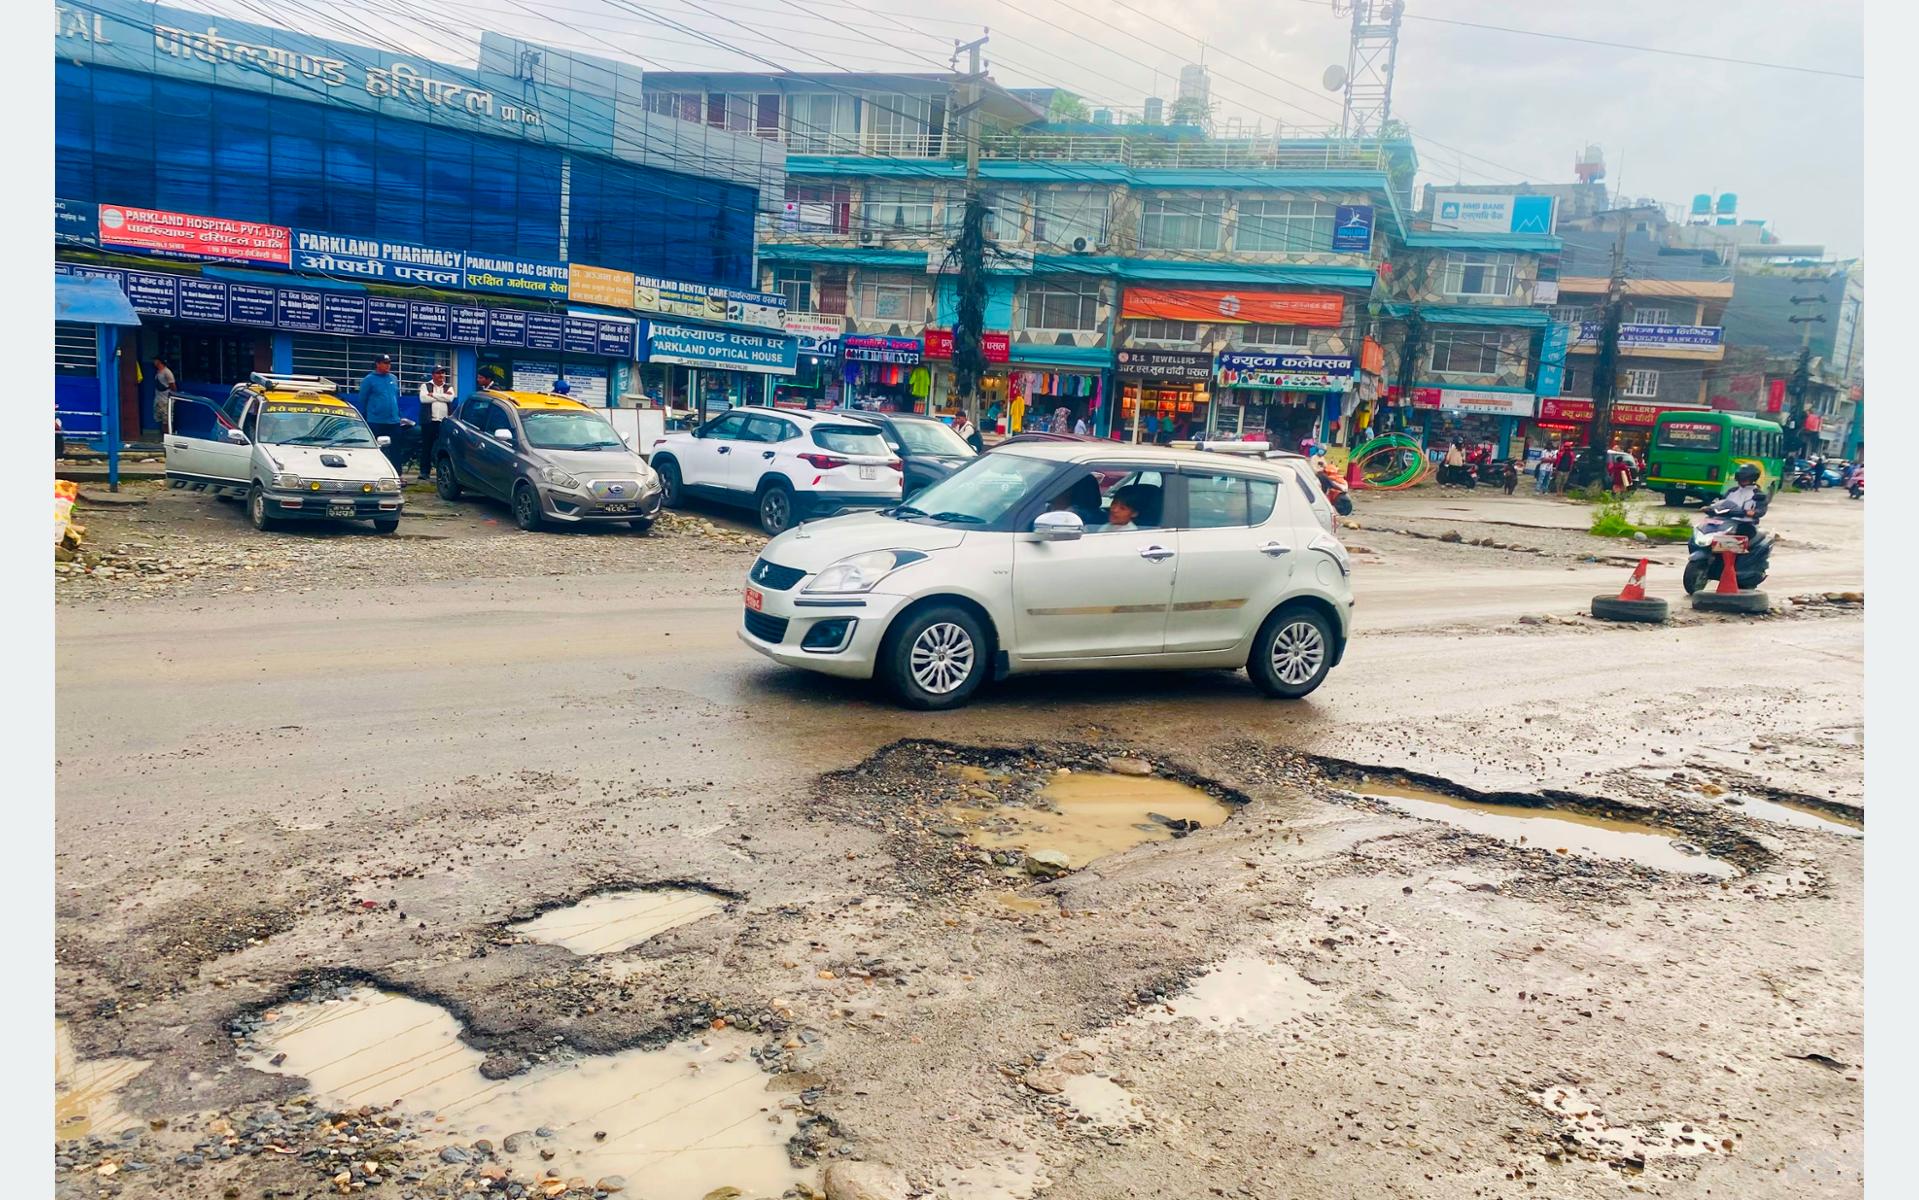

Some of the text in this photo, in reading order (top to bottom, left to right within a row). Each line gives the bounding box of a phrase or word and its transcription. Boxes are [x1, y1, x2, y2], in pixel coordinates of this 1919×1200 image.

[125, 209, 183, 226] PARKLAND
[186, 217, 238, 232] HOSPITAL
[240, 224, 262, 236] PVT.
[300, 233, 461, 268] PARKLAND PHARMACY
[300, 253, 459, 284] औषधी पसल
[466, 257, 568, 279] PARKLAND CAC CENTER
[467, 274, 504, 287] सुरक्षित
[507, 277, 546, 291] गर्भपतन
[549, 280, 567, 293] सेवा
[635, 275, 678, 291] PARKLAND
[679, 281, 707, 295] DENTAL
[708, 287, 728, 298] CARE
[655, 322, 727, 343] पार्कल्याण्ड
[767, 337, 785, 350] घर
[986, 342, 1006, 351] पसल
[708, 346, 749, 359] OPTICAL
[752, 351, 782, 363] HOUSE
[1151, 355, 1196, 364] JEWELLERS
[1186, 368, 1209, 377] पसल
